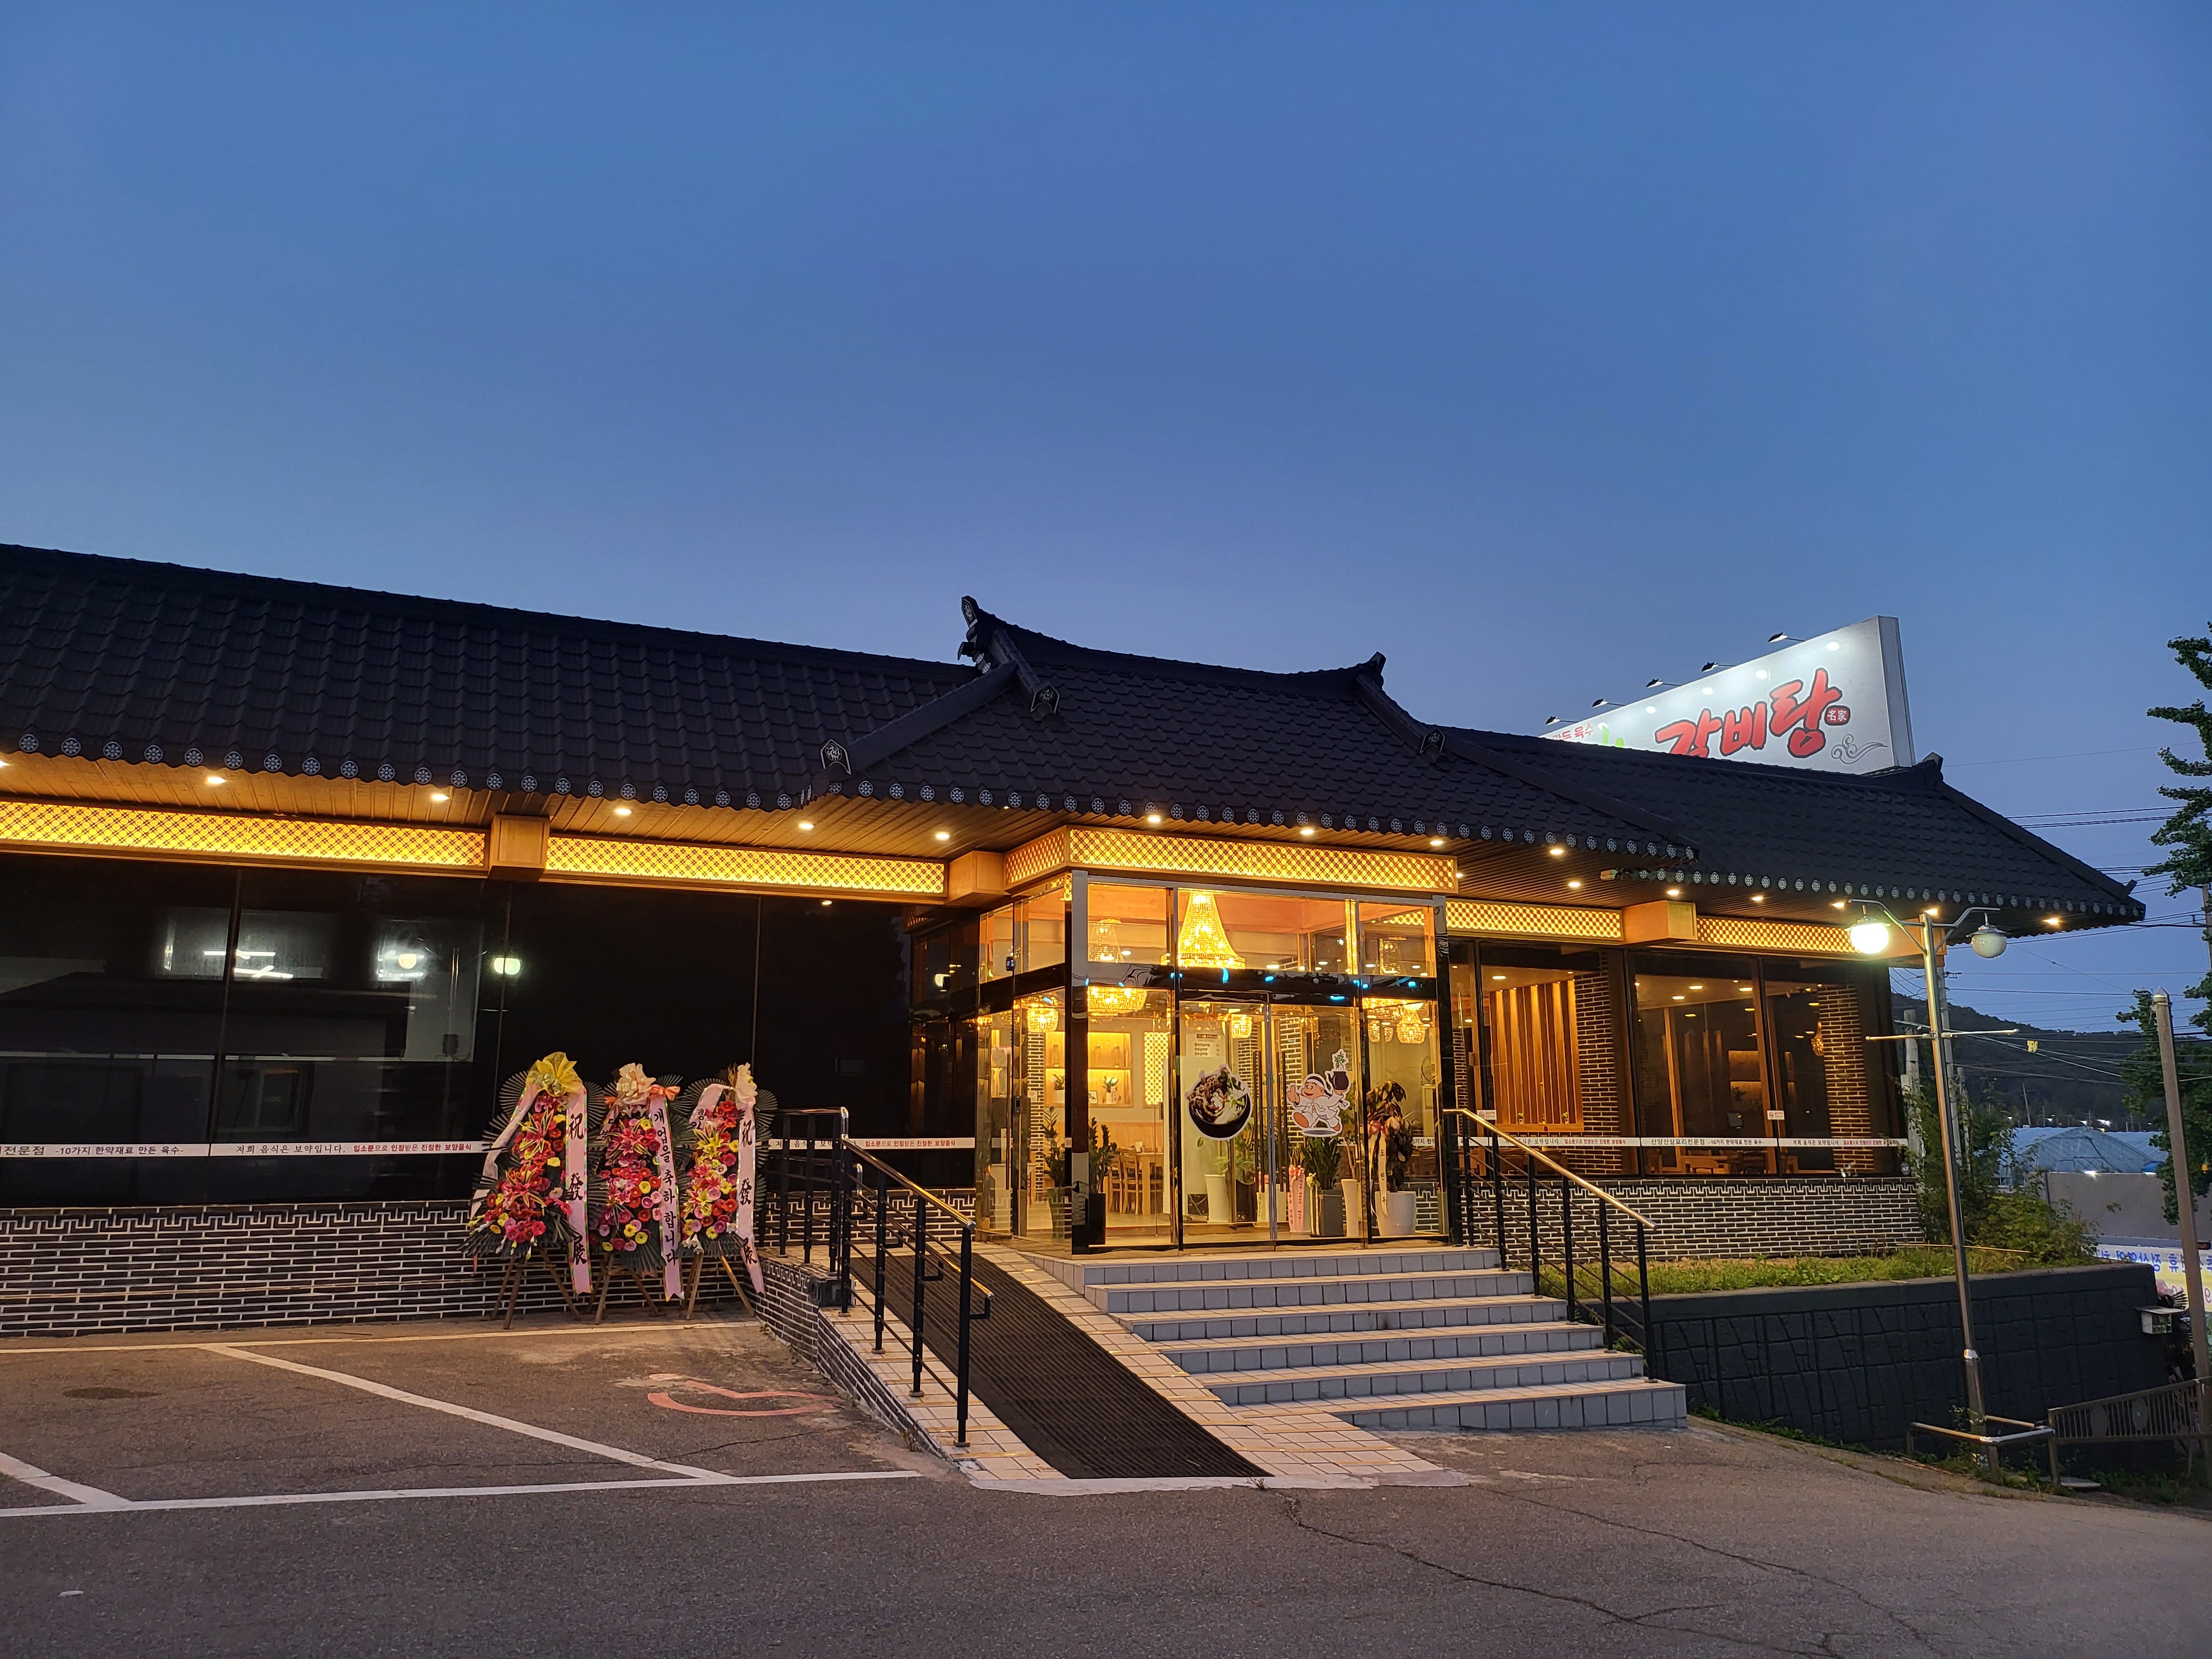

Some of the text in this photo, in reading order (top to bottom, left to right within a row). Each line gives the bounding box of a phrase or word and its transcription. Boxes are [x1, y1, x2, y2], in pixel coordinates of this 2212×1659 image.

[1655, 667, 1843, 758] 갈비탕
[1827, 709, 1847, 722] 名家
[1574, 723, 1595, 739] 육수
[0, 1146, 45, 1155] 전문점
[95, 1146, 134, 1155] 한약재료
[138, 1146, 157, 1155] 만든
[236, 1144, 346, 1154] 저희 음식은 보약입니다.
[654, 1108, 679, 1267] 개업을 축하합니다
